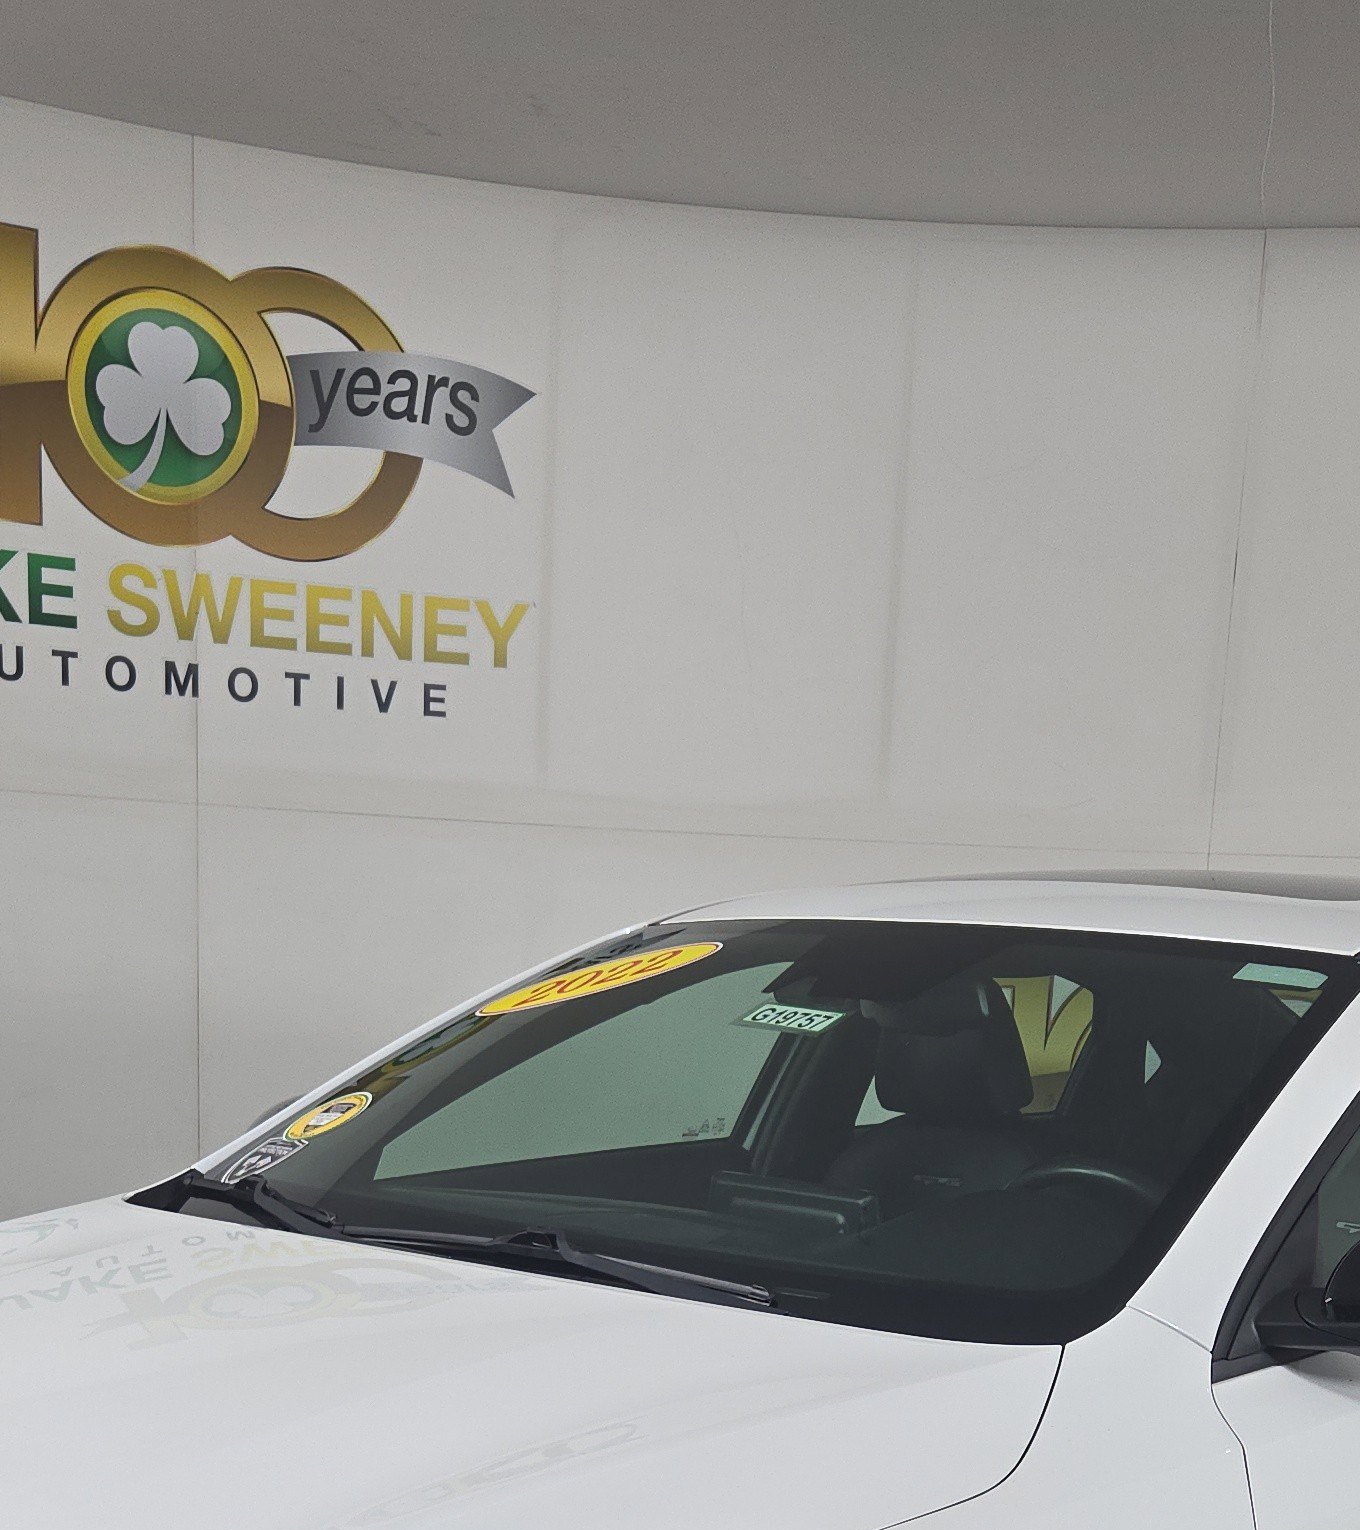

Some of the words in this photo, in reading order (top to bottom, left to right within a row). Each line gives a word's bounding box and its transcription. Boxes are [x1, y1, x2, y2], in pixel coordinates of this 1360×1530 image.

[308, 366, 481, 436] years
[107, 563, 533, 669] SWEENEY
[512, 949, 684, 1008] 2022
[751, 1007, 834, 1030] G19757
